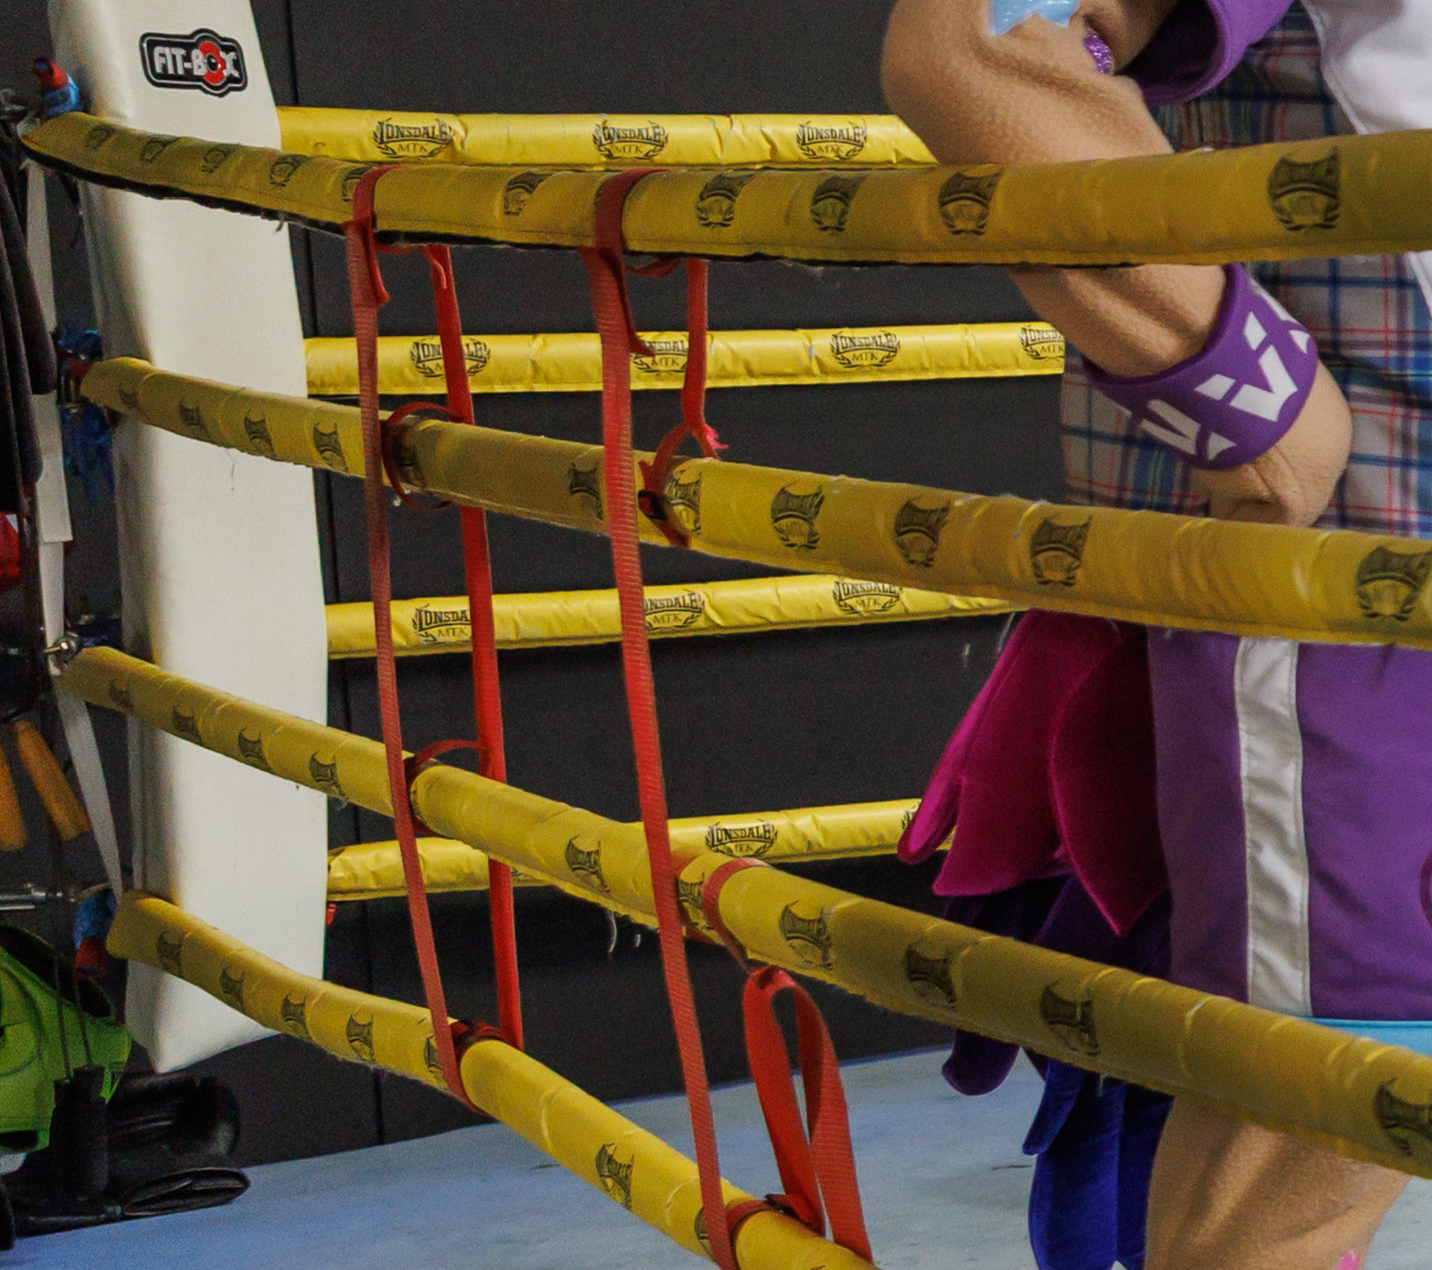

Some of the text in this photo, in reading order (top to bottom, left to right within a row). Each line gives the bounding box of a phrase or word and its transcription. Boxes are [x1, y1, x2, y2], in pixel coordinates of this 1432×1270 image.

[153, 42, 242, 80] FIT-BOX
[378, 120, 450, 146] LONSDALE
[600, 124, 665, 149] LONSDALE
[800, 122, 864, 147] LONSDALE
[836, 334, 898, 352] LONSDALE
[838, 581, 899, 602] LONSDALE
[417, 606, 471, 630] LONSDA
[712, 822, 772, 847] LONSDALE
